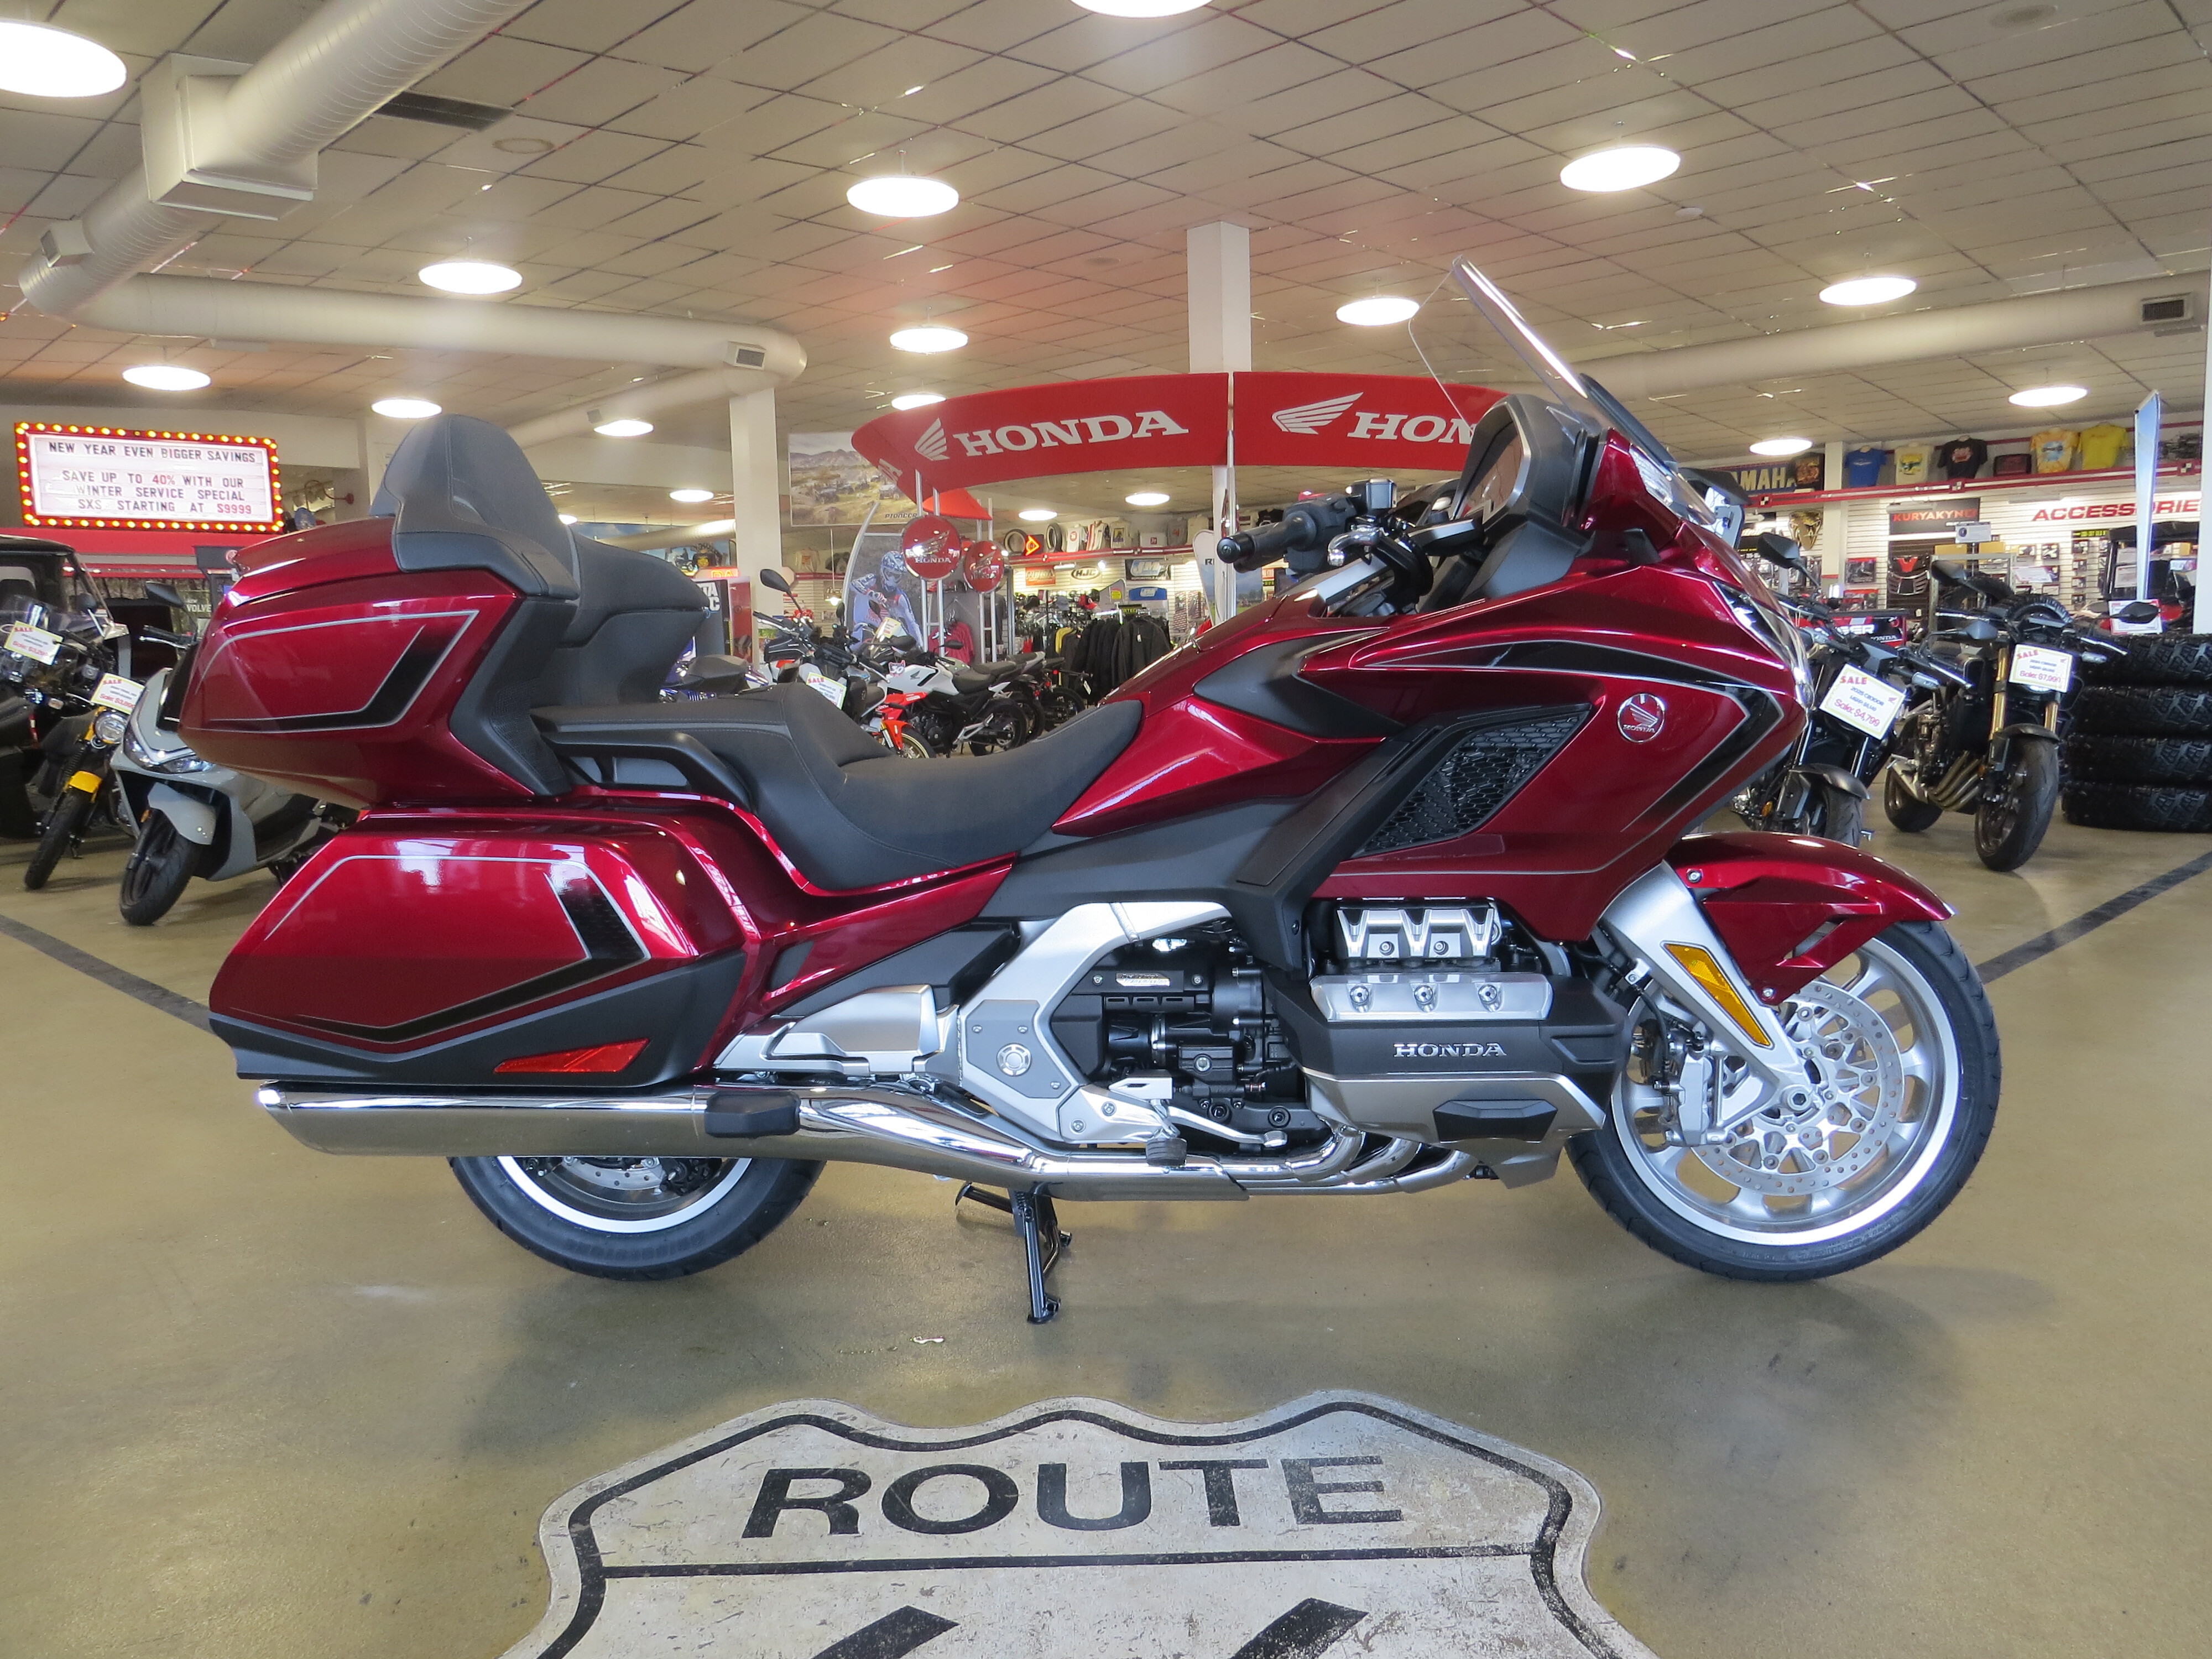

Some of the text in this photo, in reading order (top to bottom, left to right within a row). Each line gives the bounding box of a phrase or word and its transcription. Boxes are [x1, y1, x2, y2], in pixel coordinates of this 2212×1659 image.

[952, 410, 1190, 457] HONDA
[1347, 411, 1478, 445] HON
[49, 441, 255, 462] NEW YEAR EVEN BIGGER SAVINGS
[62, 469, 243, 488] SAVE UP TO 40% WITH OUR
[1730, 467, 1797, 491] MAH
[75, 484, 245, 501] WINTER SERVICE SPECIAL
[78, 498, 102, 509] SXS
[117, 500, 175, 512] STARTING
[190, 502, 204, 513] AT
[2031, 499, 2201, 521] ACCESSRIE
[1074, 567, 1097, 576] HJC
[2016, 649, 2039, 660] SALE
[1839, 675, 1868, 685] SALE
[1834, 698, 1854, 714] Sale:
[1623, 724, 1656, 733] HONDA
[1393, 1042, 1507, 1058] HONDA
[742, 1454, 1403, 1539] ROUTE
